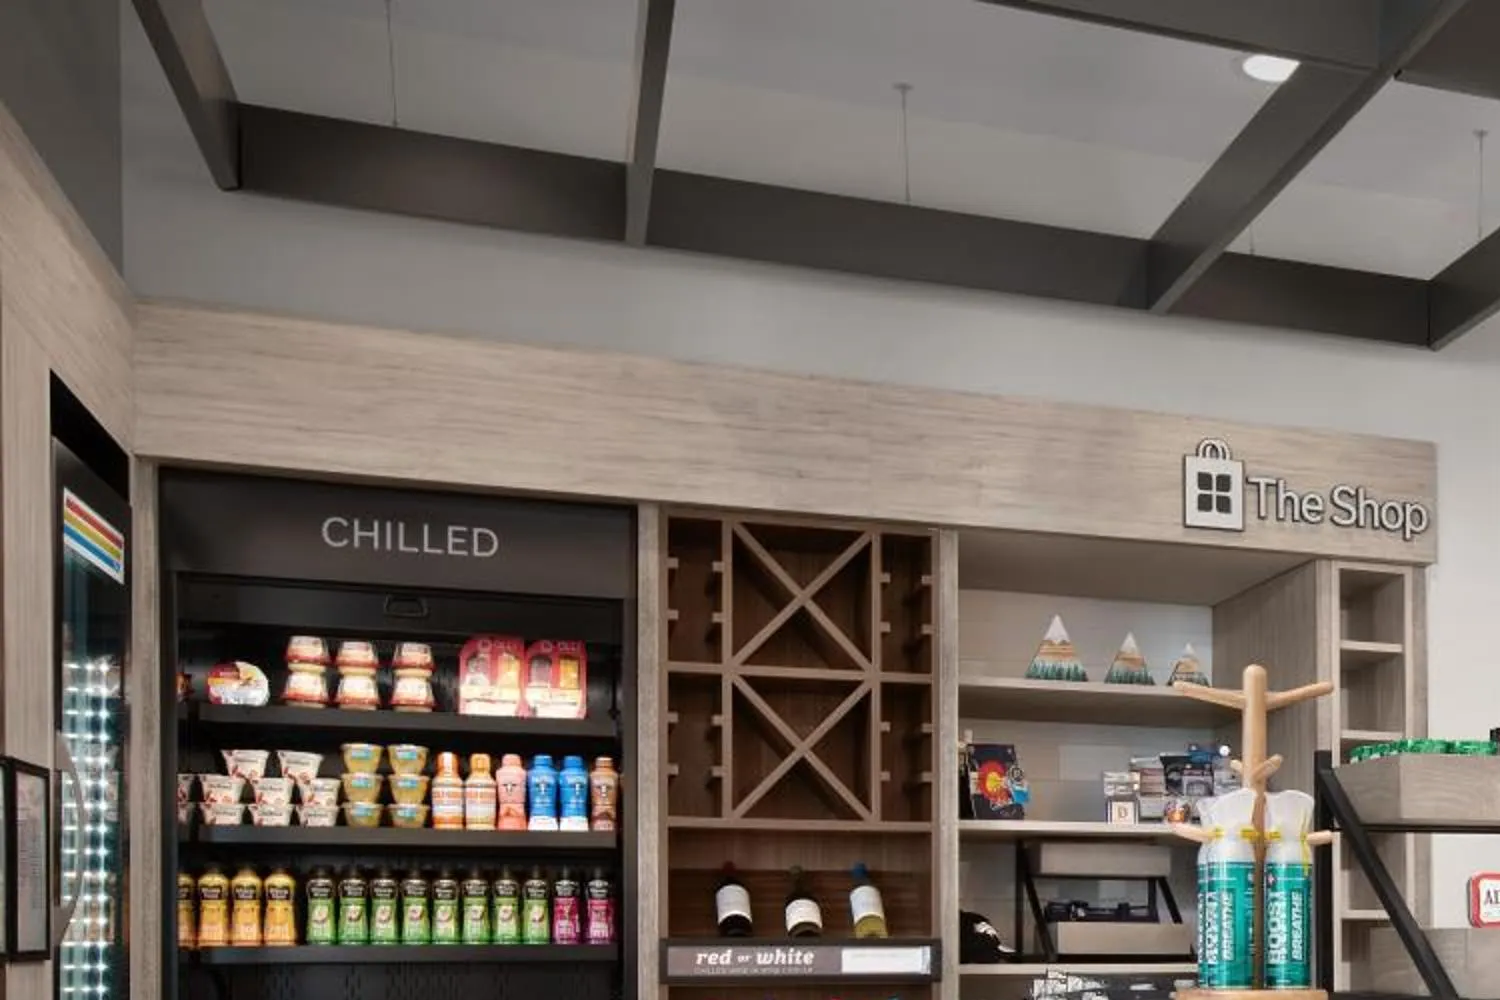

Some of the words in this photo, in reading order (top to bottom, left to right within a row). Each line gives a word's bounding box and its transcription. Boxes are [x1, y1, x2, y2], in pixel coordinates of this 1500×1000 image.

[1246, 477, 1325, 524] The
[1330, 484, 1430, 540] Shop
[321, 516, 499, 559] CHILLED
[1291, 891, 1303, 961] BREATHE
[696, 949, 732, 965] red
[757, 948, 815, 965] white
